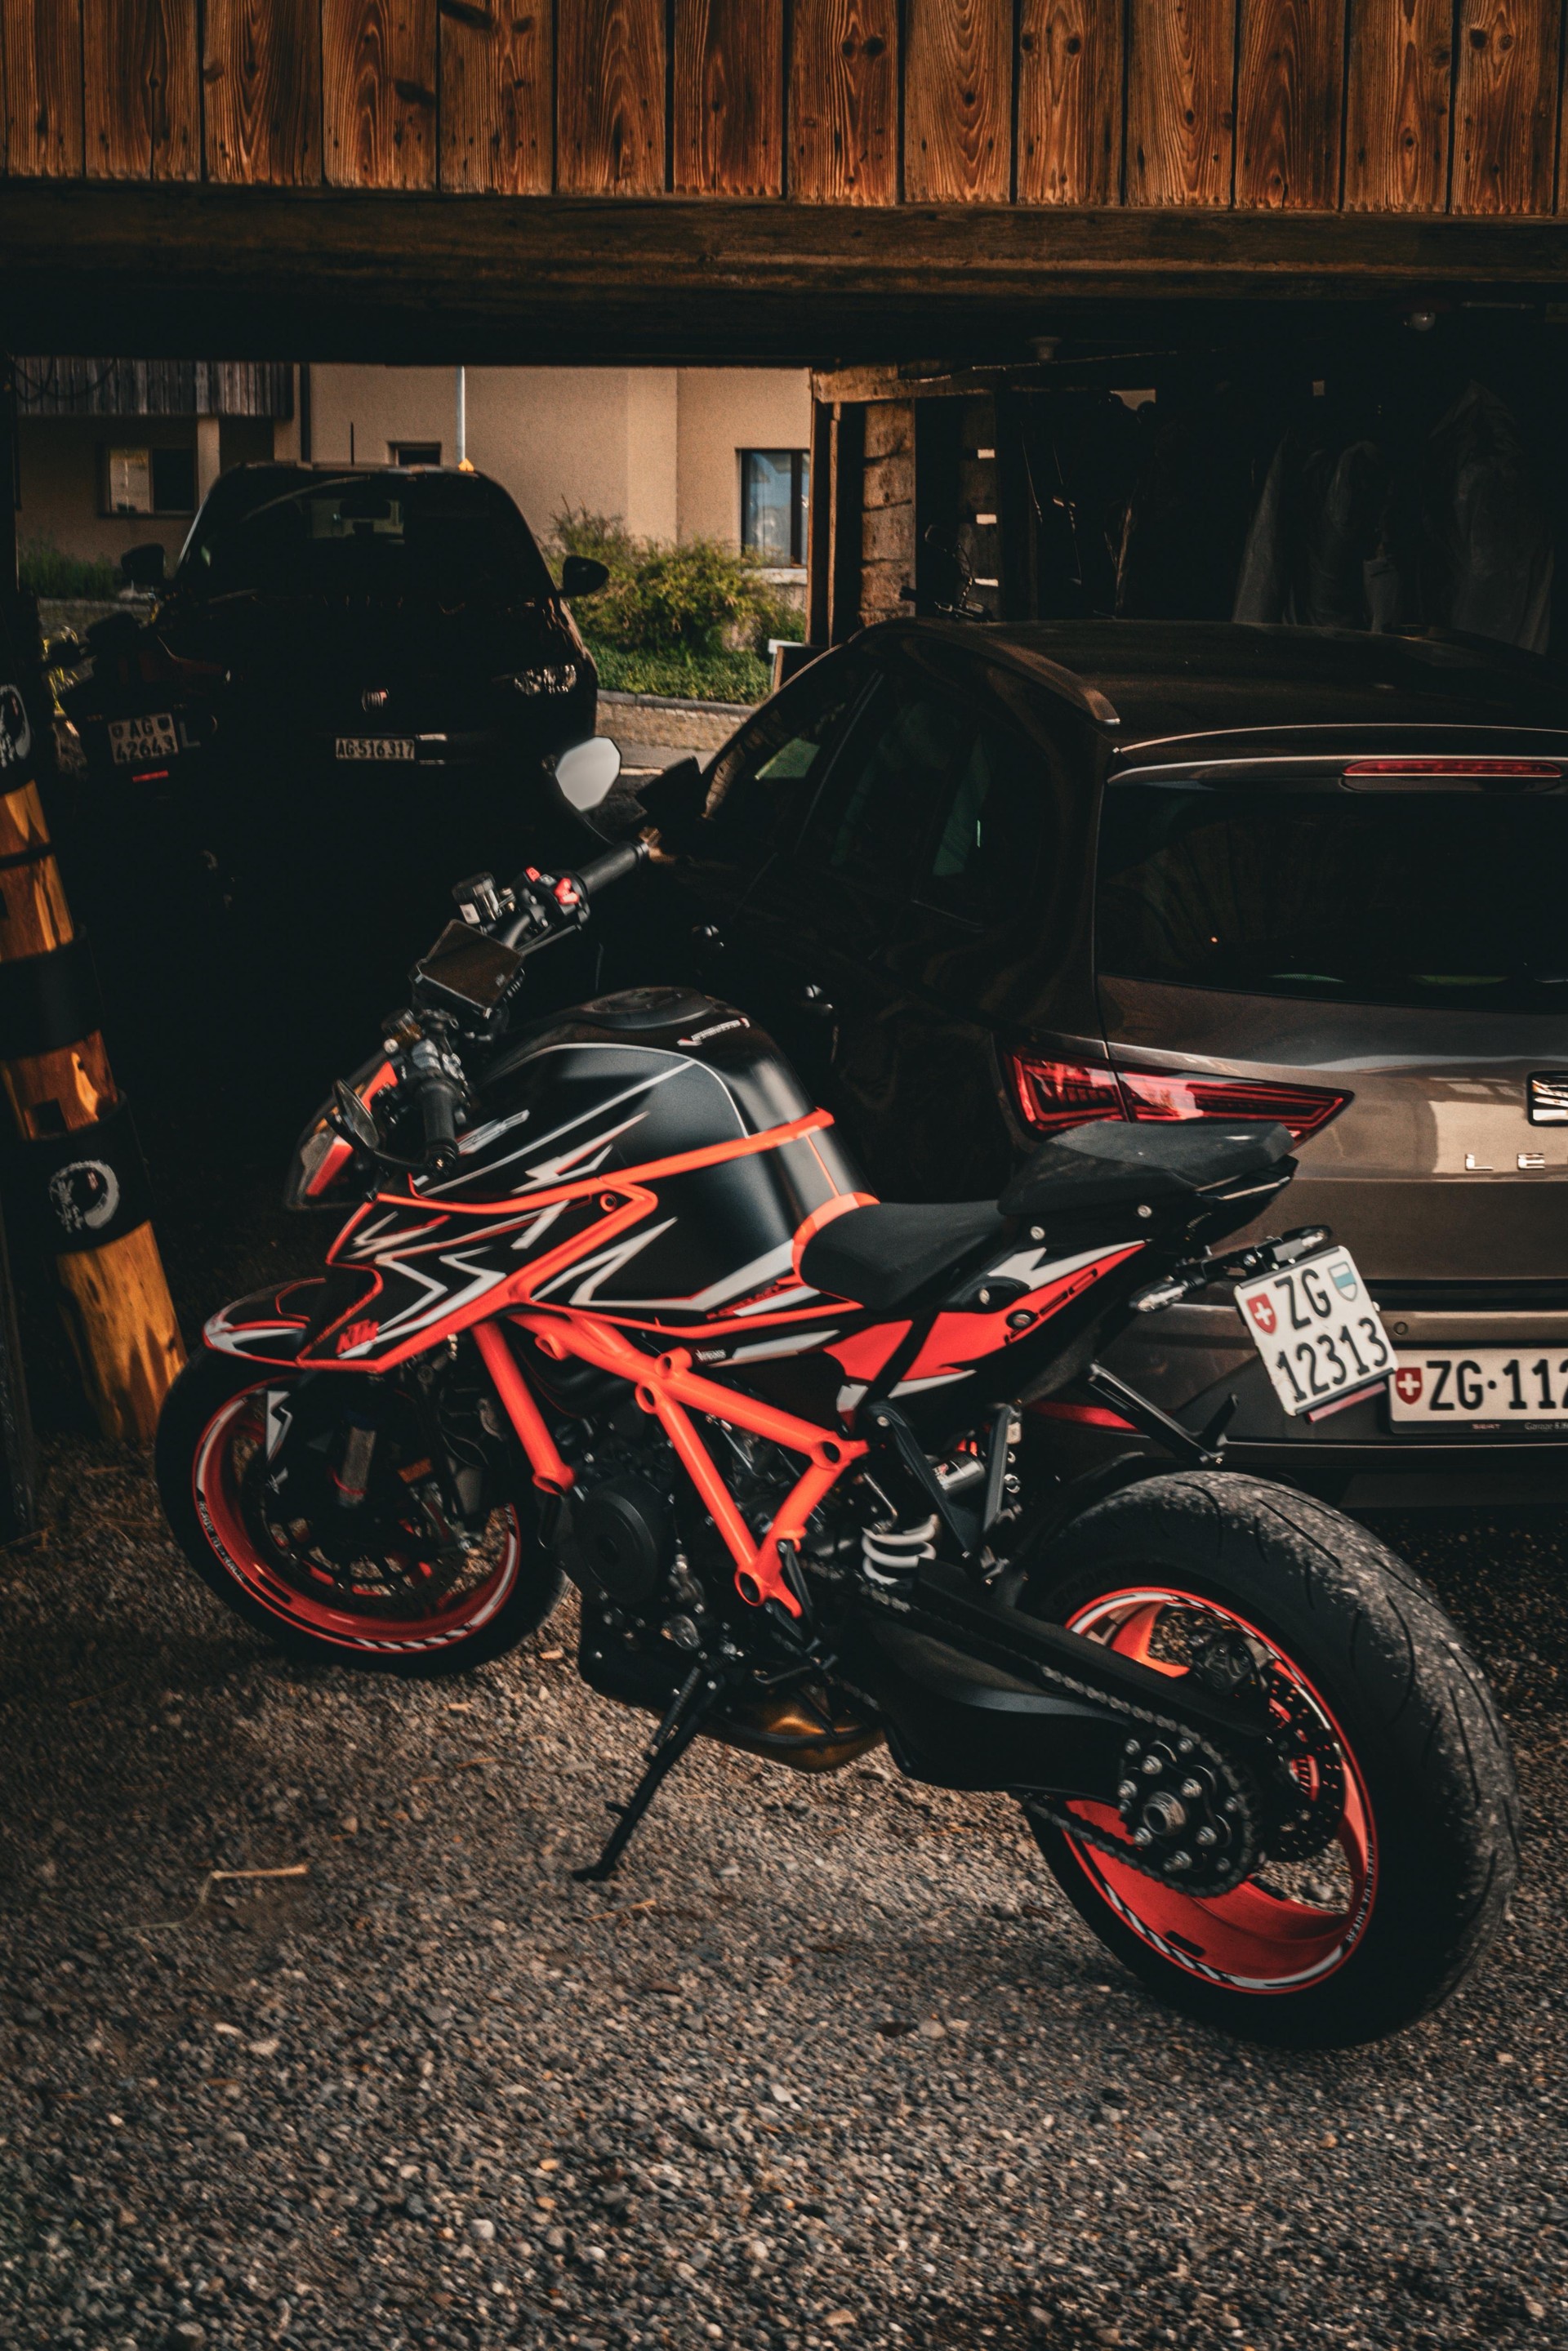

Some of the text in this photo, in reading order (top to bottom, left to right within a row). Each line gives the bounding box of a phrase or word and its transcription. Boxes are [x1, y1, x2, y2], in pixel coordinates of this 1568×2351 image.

[130, 718, 154, 738] AG
[116, 736, 175, 761] 42643
[1274, 1268, 1331, 1330] ZG
[335, 1318, 380, 1355] KTM
[1276, 1317, 1388, 1403] 12313
[1345, 1906, 1367, 1943] READY
